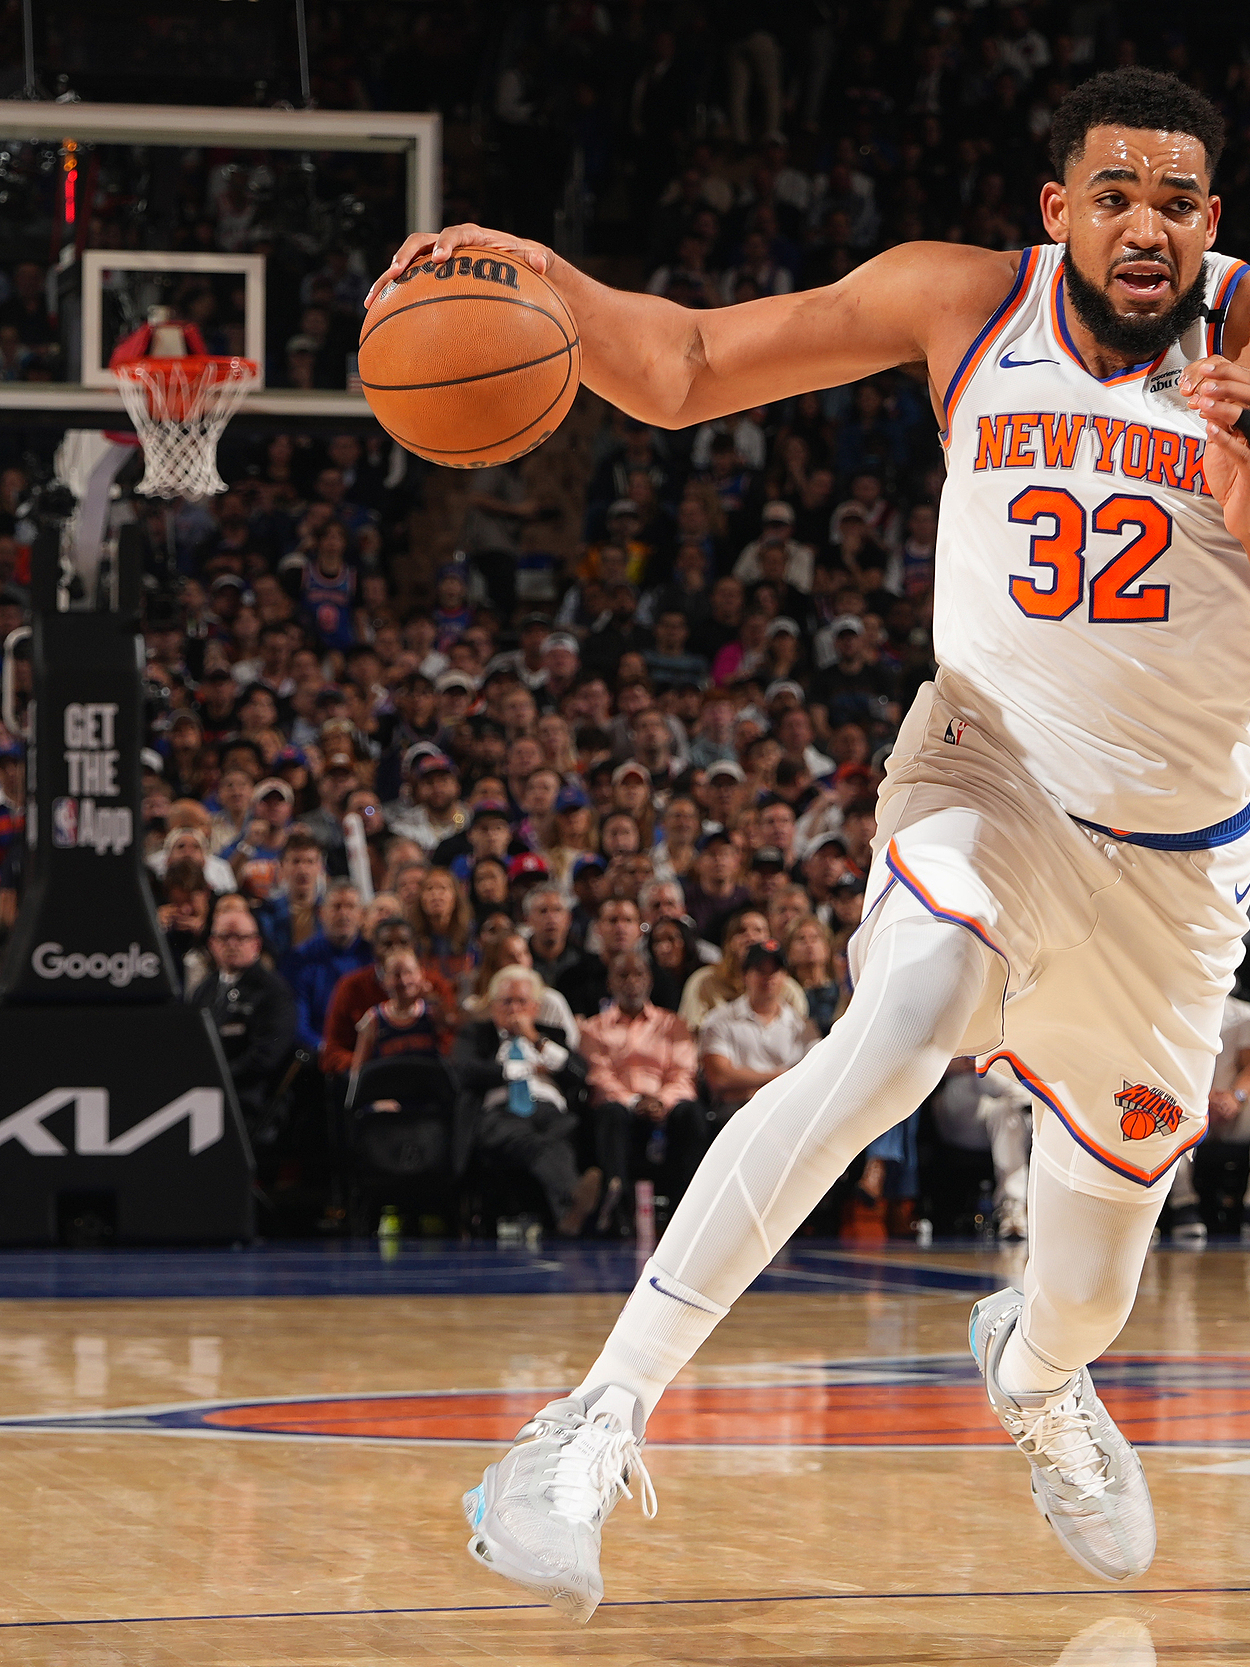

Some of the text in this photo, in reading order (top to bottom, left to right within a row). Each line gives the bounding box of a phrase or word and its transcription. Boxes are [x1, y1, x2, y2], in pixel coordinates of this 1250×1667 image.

[1150, 378, 1172, 393] abu
[973, 411, 1213, 498] NEW YORK
[1008, 485, 1172, 623] 32
[64, 702, 119, 750] GET
[63, 750, 121, 797] THE
[78, 798, 133, 857] App
[32, 942, 161, 988] Google
[1114, 1083, 1184, 1136] KNICKS
